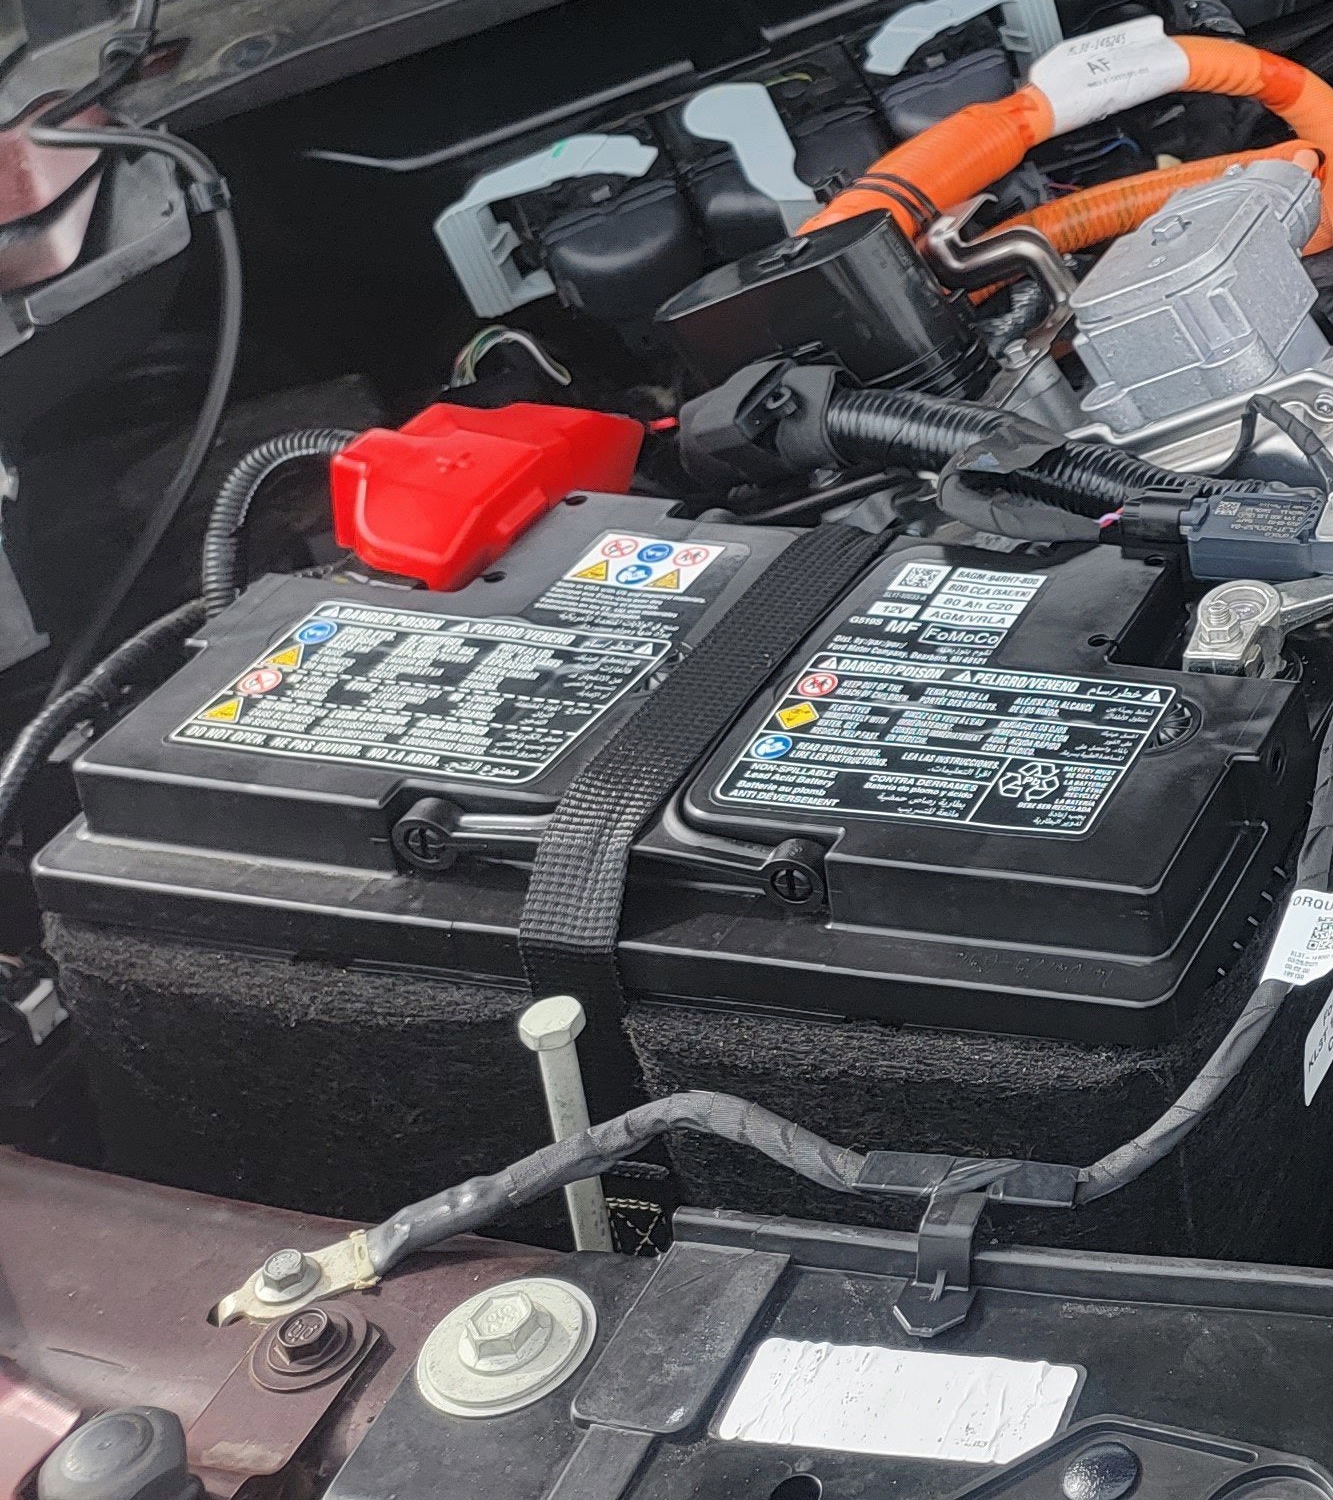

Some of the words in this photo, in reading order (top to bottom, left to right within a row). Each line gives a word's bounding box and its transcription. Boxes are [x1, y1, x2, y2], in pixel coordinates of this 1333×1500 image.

[947, 584, 969, 592] 800
[969, 586, 992, 594] CCA
[942, 597, 962, 605] 80
[961, 600, 984, 609] Ah
[984, 601, 1013, 611] C20
[335, 608, 448, 630] DANGER/POISON
[879, 605, 908, 614] 12V
[928, 610, 1007, 625] AGM/VRLA
[466, 622, 579, 645] PELIGRO/VENENO
[883, 619, 923, 634] MF
[923, 627, 1002, 646] FoMoCo
[844, 644, 872, 653] Motor
[835, 658, 946, 680] DANGER/POISON
[970, 671, 1081, 693] PELIGRO/VENENO
[183, 725, 210, 736] DO
[202, 728, 235, 740] NOT
[227, 731, 272, 745] OPEN.
[266, 736, 294, 748] NE
[284, 738, 318, 751] PAS
[309, 741, 368, 757] OUVRIR.
[363, 748, 390, 759] NO
[382, 750, 408, 761] LA
[400, 752, 448, 767] ABRA.
[788, 750, 809, 758] LIRE
[807, 752, 827, 760] LES
[825, 753, 891, 767] INSTRUCTIONS.
[900, 752, 920, 760] LEA
[917, 753, 937, 762] LAS
[934, 755, 1003, 769] INSTRUCCIONES.
[742, 771, 772, 780] Lead
[769, 773, 797, 782] Acid
[793, 776, 836, 787] Battery
[748, 763, 839, 778] NON-SPILLABLE
[734, 780, 779, 790] Batterie
[790, 786, 828, 796] plomb
[867, 774, 917, 785] CONTRA
[914, 778, 979, 791] DERRAMES
[1020, 776, 1043, 786] Pb
[727, 789, 757, 798] ANTI
[753, 791, 841, 806] DÉVERSEMENT
[907, 787, 941, 796] plomo
[1308, 1028, 1328, 1073] KL3T
